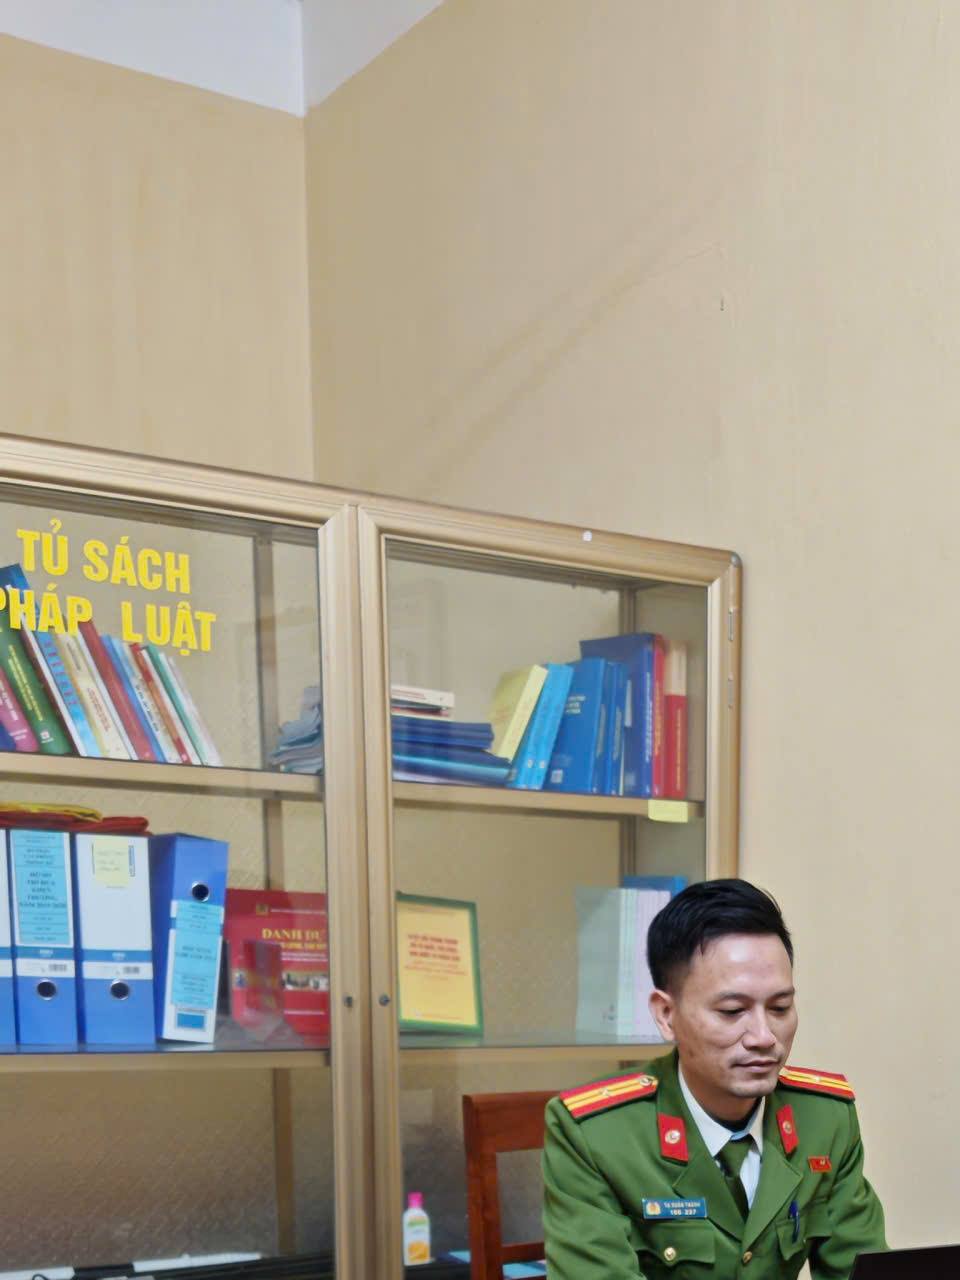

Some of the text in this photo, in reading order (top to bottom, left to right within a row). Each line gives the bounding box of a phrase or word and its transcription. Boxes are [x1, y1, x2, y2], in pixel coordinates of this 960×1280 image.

[16, 517, 190, 593] TỦ SÁCH
[121, 601, 216, 656] LUẬT
